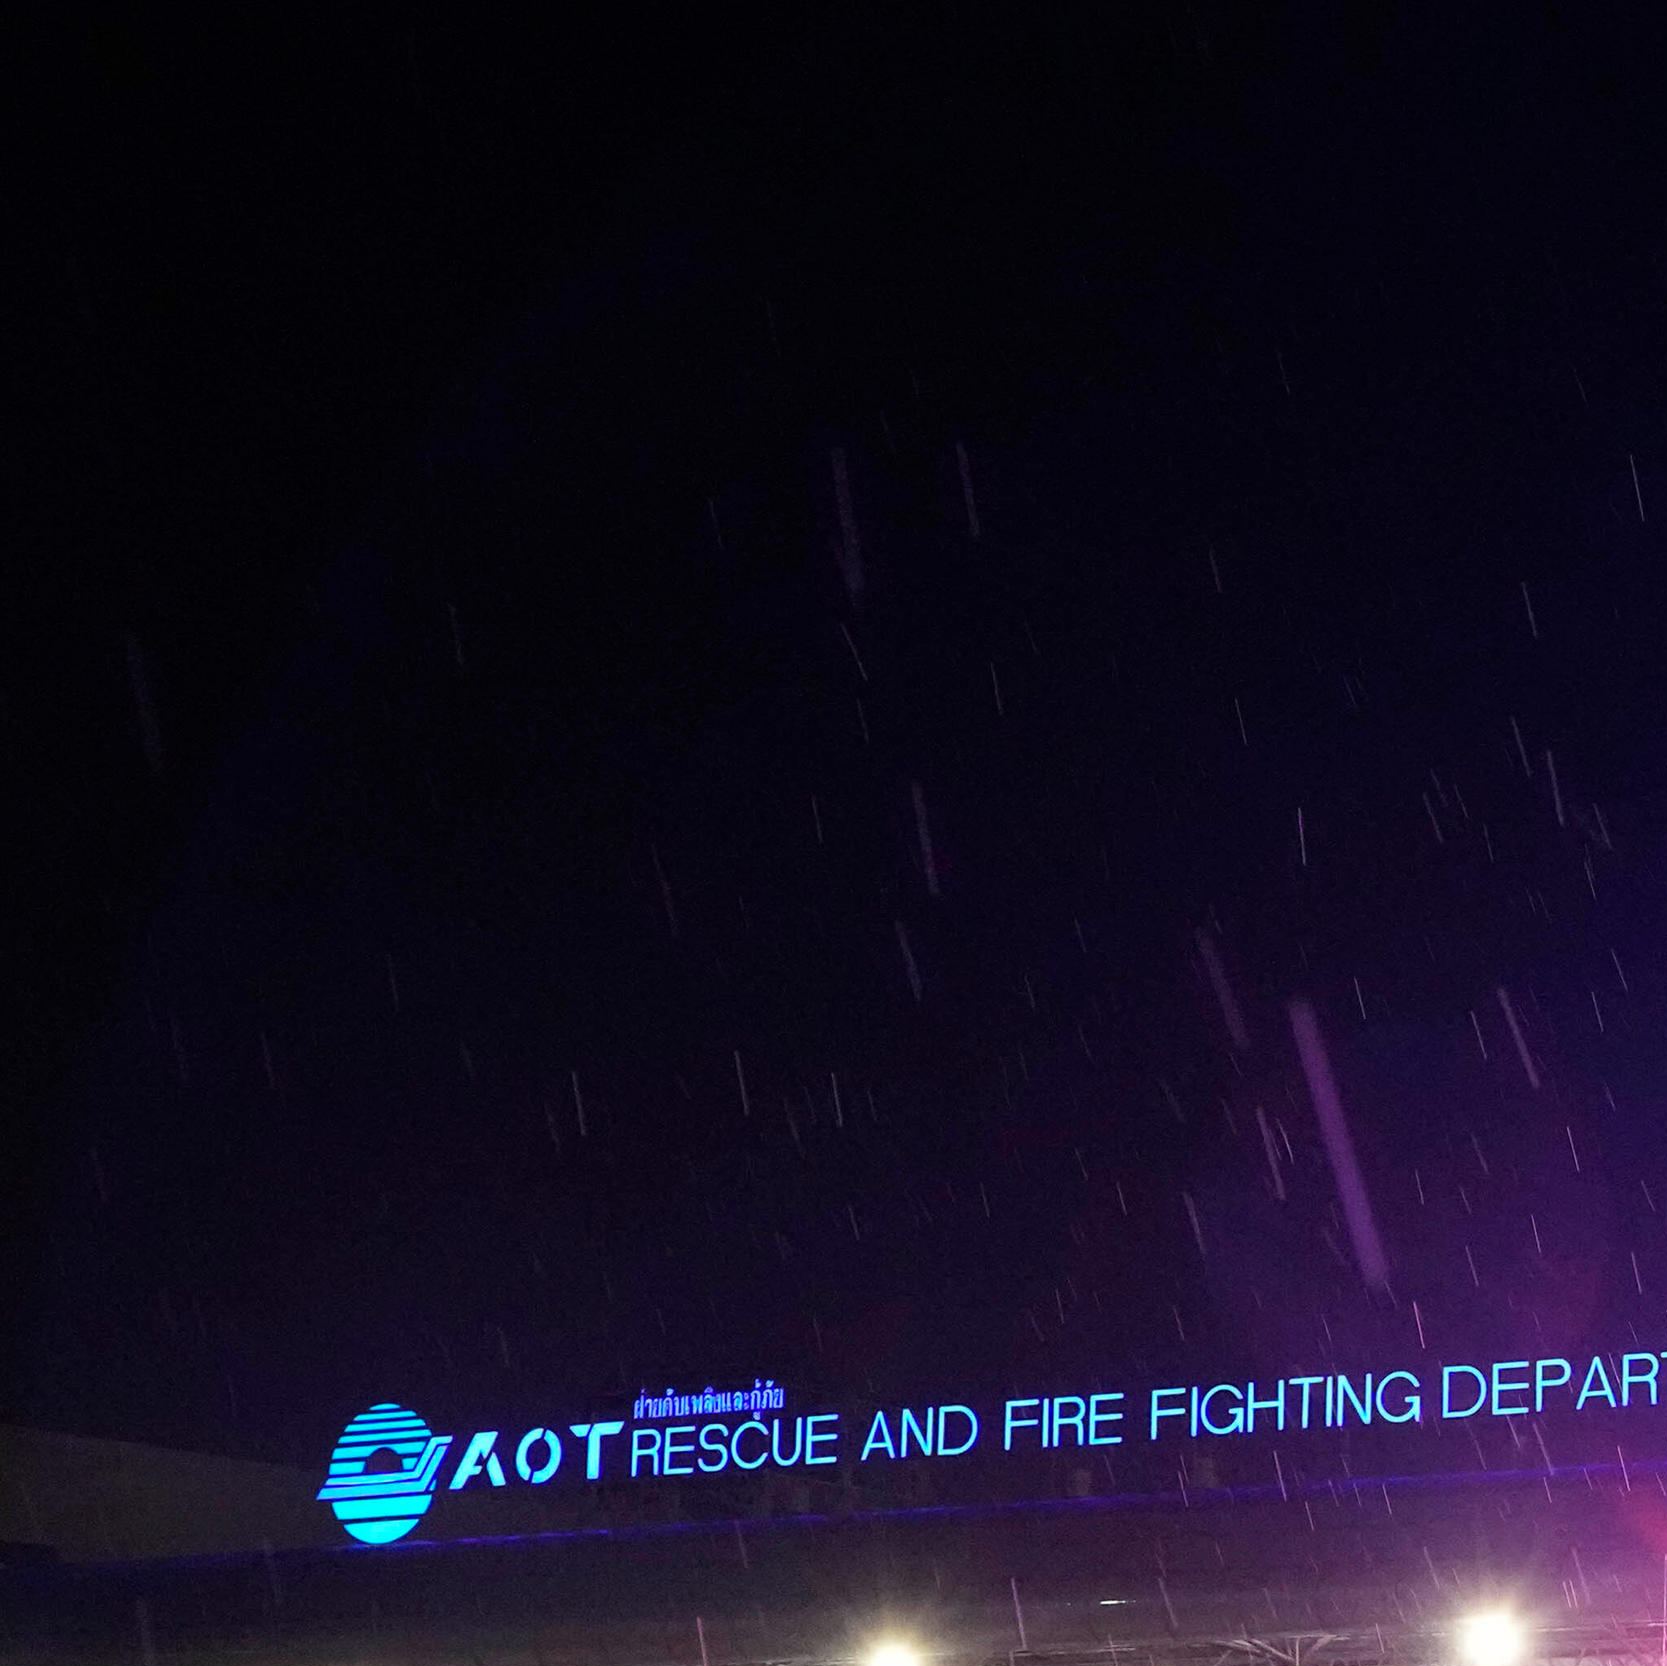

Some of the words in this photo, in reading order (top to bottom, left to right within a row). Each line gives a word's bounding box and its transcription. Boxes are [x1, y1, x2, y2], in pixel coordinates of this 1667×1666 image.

[449, 1421, 625, 1489] AOT
[631, 1414, 839, 1477] RESCUE
[861, 1405, 979, 1461] AND
[1004, 1393, 1124, 1451] FIRE
[1150, 1371, 1421, 1441] FIGHTING
